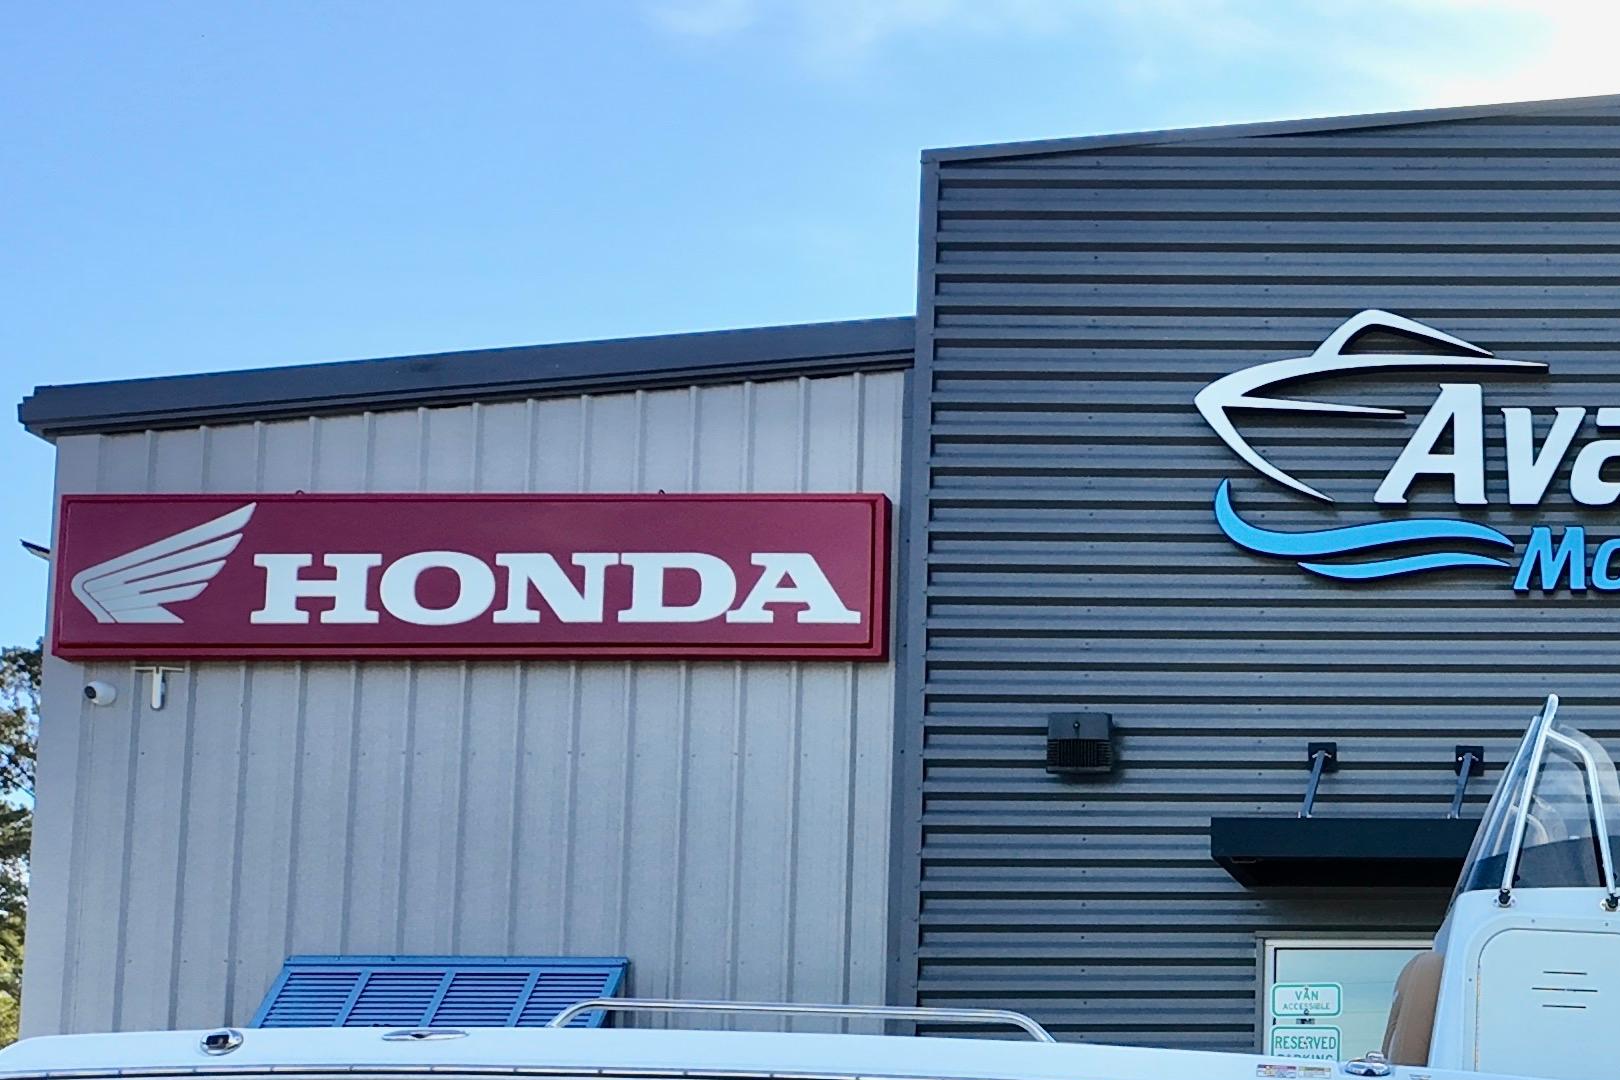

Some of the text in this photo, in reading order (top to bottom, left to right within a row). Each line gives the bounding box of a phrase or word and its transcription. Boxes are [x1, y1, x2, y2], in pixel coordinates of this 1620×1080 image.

[250, 550, 861, 626] HONDA
[1295, 990, 1319, 1001] VAN
[1282, 1002, 1330, 1010] ACCESSIBLE
[1275, 1036, 1337, 1049] RESERVED
